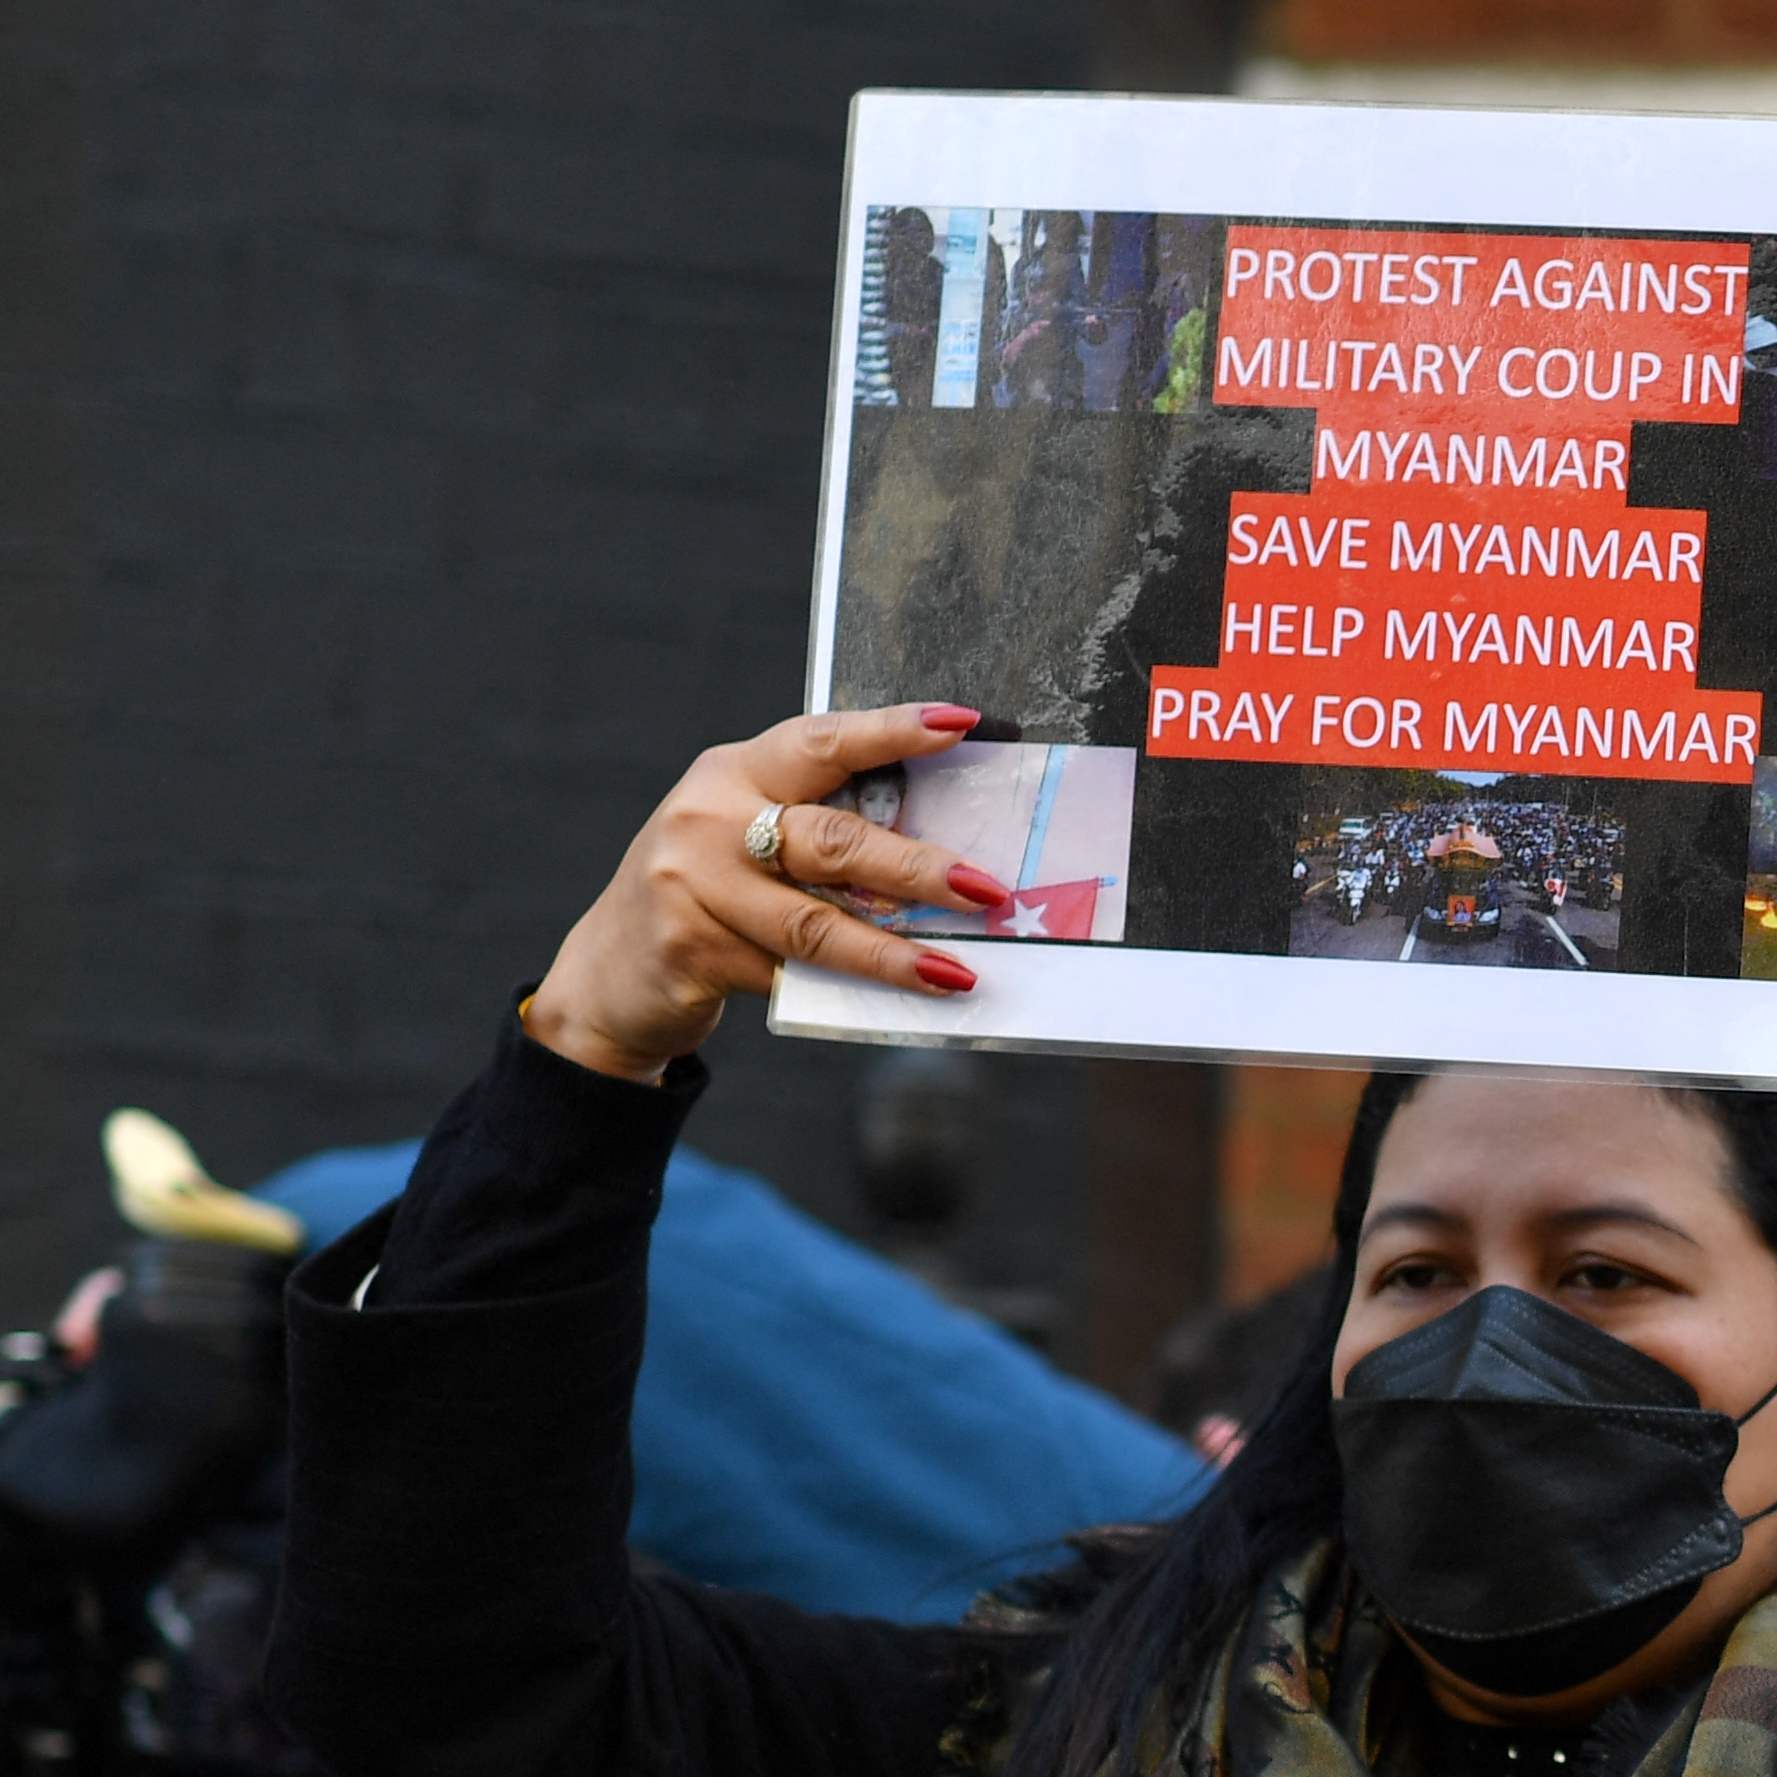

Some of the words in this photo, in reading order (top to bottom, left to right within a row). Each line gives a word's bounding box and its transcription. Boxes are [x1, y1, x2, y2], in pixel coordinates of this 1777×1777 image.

[1226, 247, 1477, 306] PROTEST
[1489, 257, 1748, 316] AGAINST
[1218, 335, 1482, 395] MILITARY
[1498, 347, 1662, 401] COUP
[1681, 353, 1740, 406] IN
[1316, 428, 1627, 491] MYANMAR
[1228, 513, 1371, 570] SAVE
[1390, 519, 1701, 584] MYANMAR
[1224, 602, 1364, 657] HELP
[1384, 609, 1696, 674] MYANMAR
[1151, 687, 1294, 744] PRAY
[1311, 695, 1422, 750] FOR
[1443, 700, 1757, 765] MYANMAR
